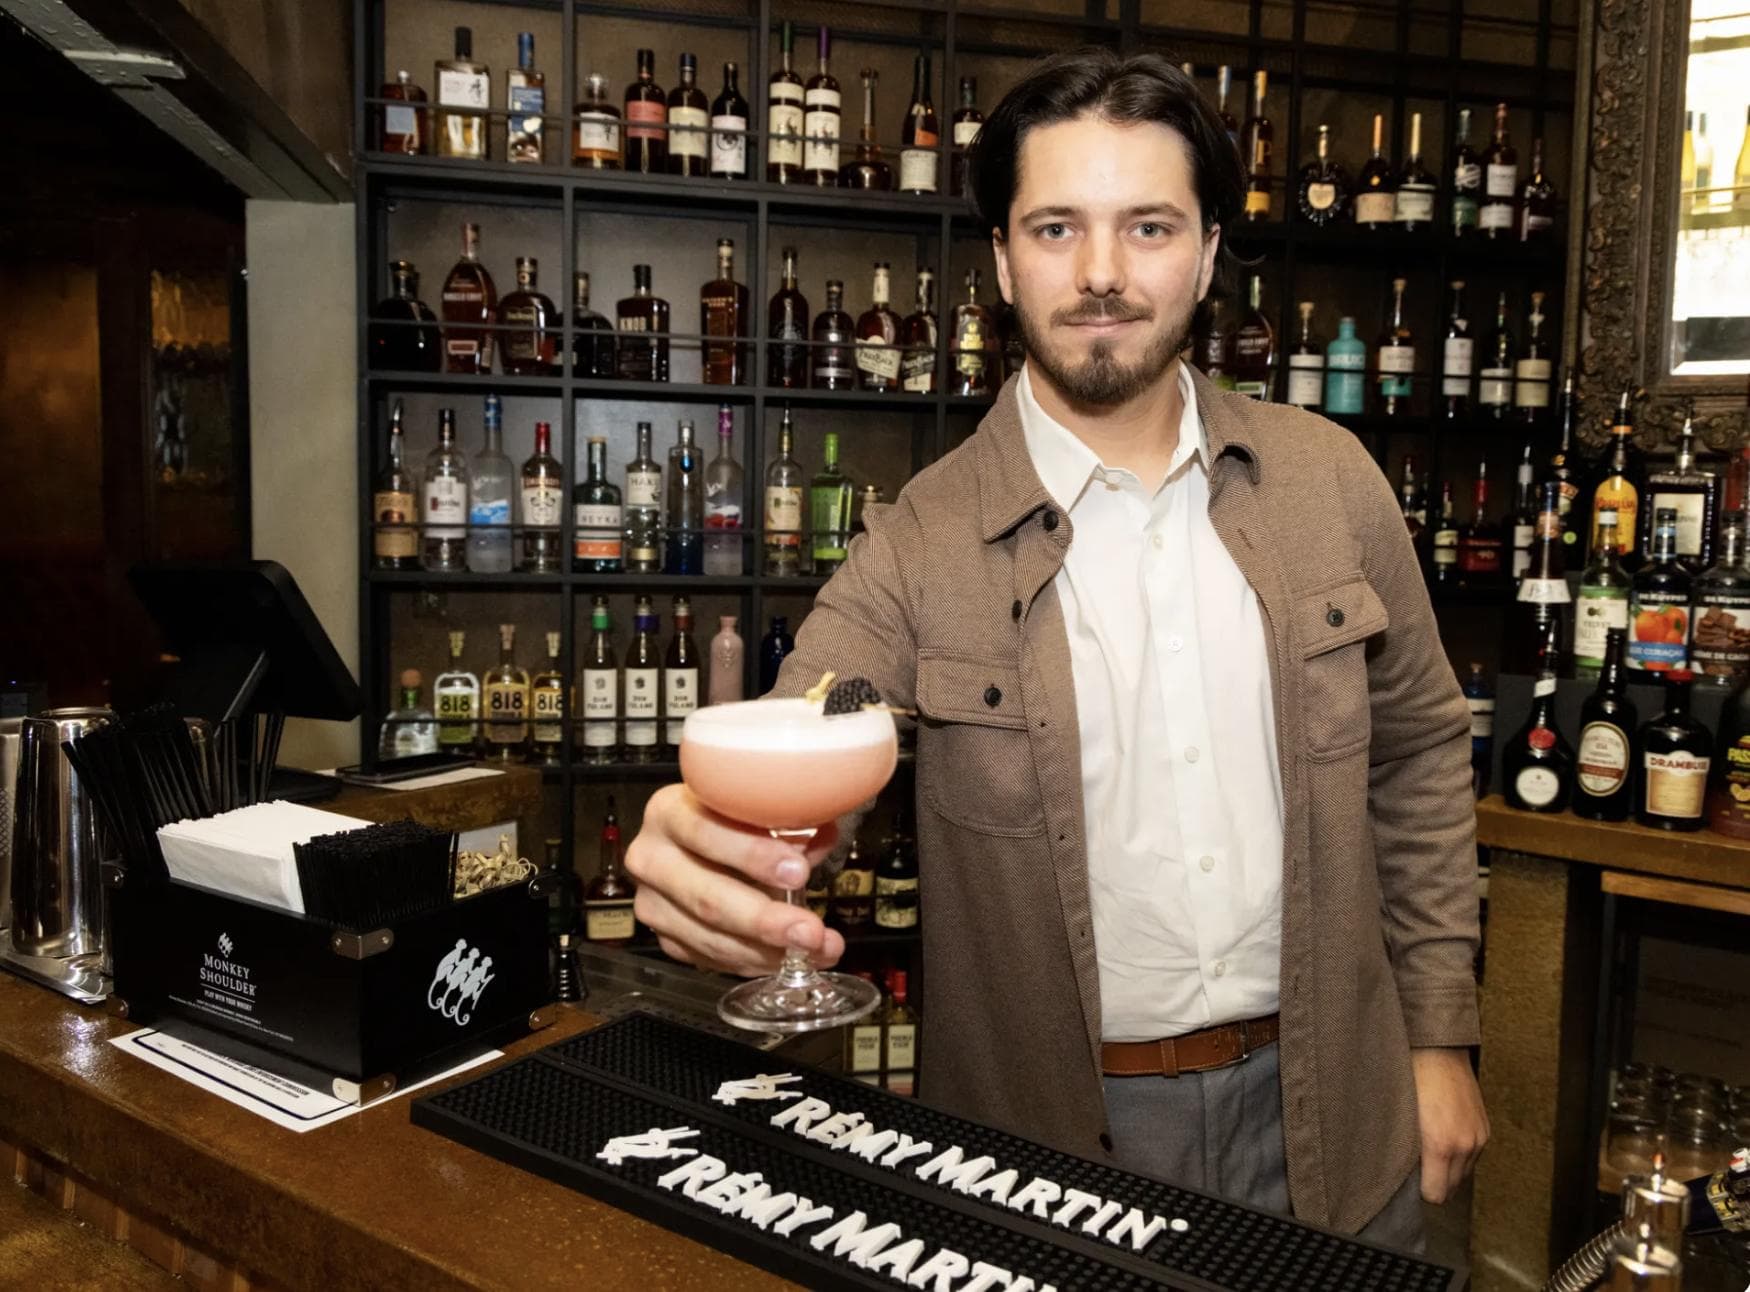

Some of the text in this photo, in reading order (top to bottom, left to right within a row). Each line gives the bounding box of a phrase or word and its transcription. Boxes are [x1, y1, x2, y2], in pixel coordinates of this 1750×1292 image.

[440, 695, 471, 712] 818
[491, 691, 523, 710] 818
[537, 694, 563, 710] 818
[204, 953, 250, 980] MONKEY
[200, 967, 256, 996] SHOULDER
[770, 1096, 1166, 1254] RÉMY MARTIN
[657, 1154, 1059, 1292] RÉMY MART
